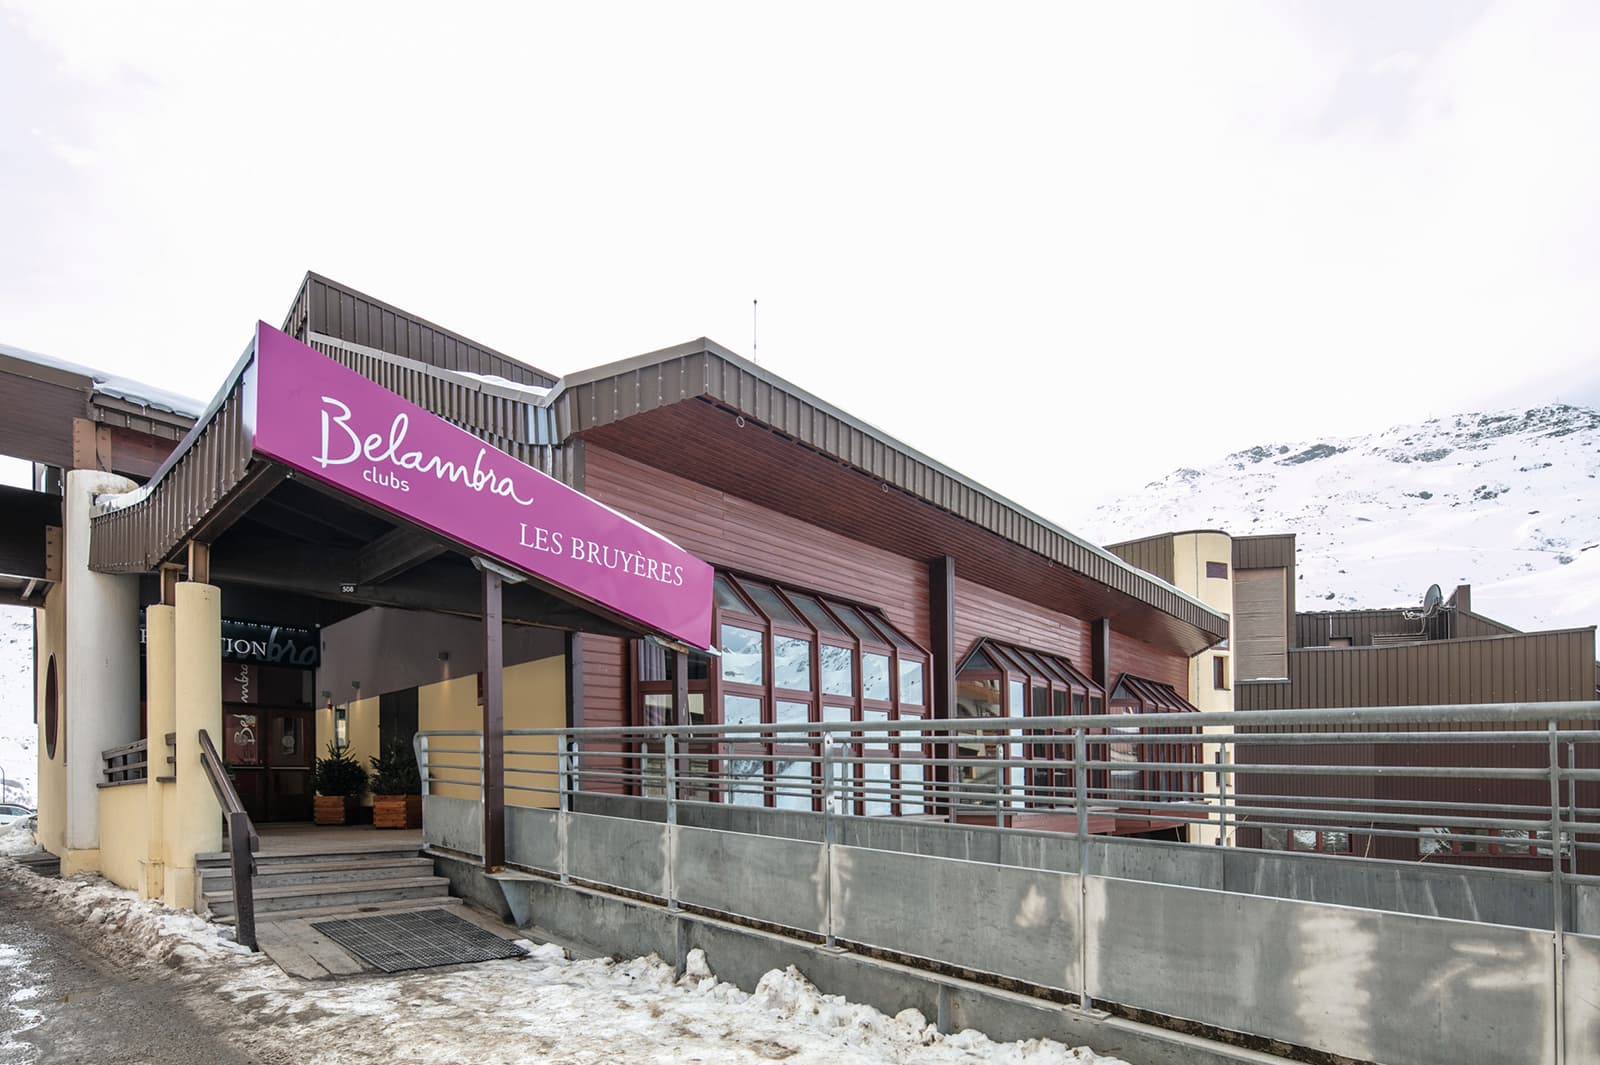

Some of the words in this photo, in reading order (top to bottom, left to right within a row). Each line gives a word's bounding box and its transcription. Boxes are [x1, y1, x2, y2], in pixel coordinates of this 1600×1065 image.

[311, 396, 535, 505] Belambra
[362, 466, 411, 493] clubs
[519, 522, 564, 555] LES
[570, 536, 685, 587] BRUYÈRES
